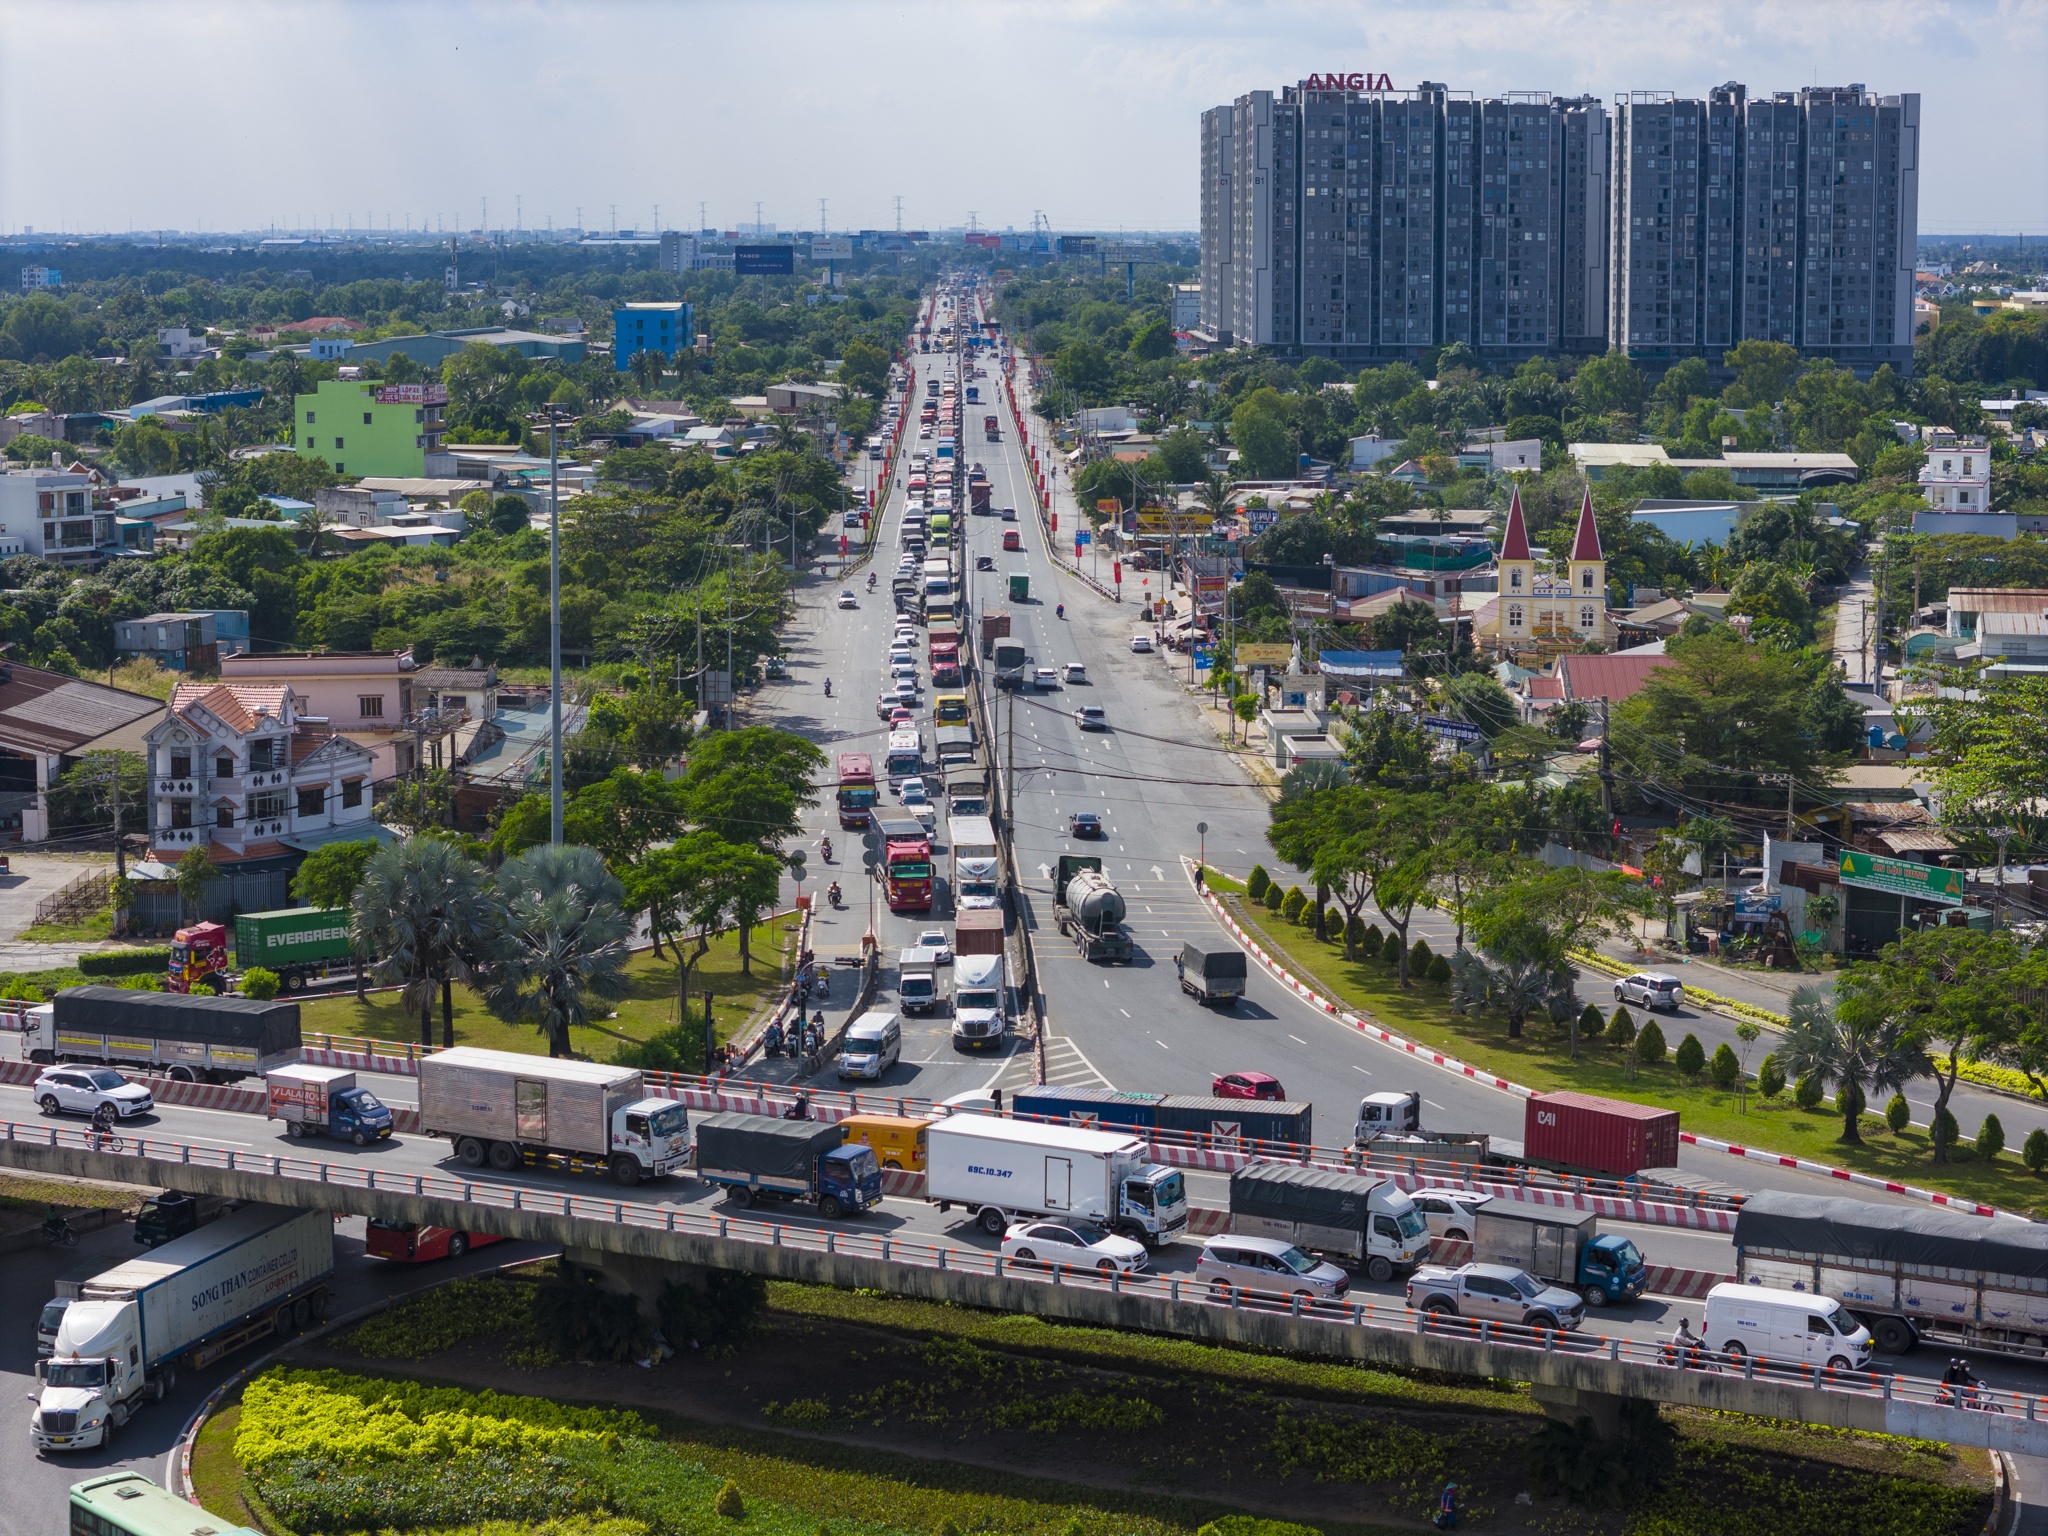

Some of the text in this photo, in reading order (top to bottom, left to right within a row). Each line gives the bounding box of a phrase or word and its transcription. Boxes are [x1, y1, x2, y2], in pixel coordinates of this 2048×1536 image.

[1305, 73, 1394, 90] ANGIA
[1220, 178, 1228, 186] C1
[1254, 176, 1265, 185] B1
[1872, 863, 1885, 873] AN
[267, 927, 349, 947] EVERGREEN
[280, 1088, 327, 1102] LALAMOVE
[1537, 1110, 1556, 1127] CAI
[968, 1165, 1013, 1178] 69C.10.347
[191, 1284, 219, 1312] SONG
[220, 1270, 247, 1297] THAN
[247, 1257, 279, 1284] CONTAINER
[264, 1269, 299, 1295] LOGISTICS
